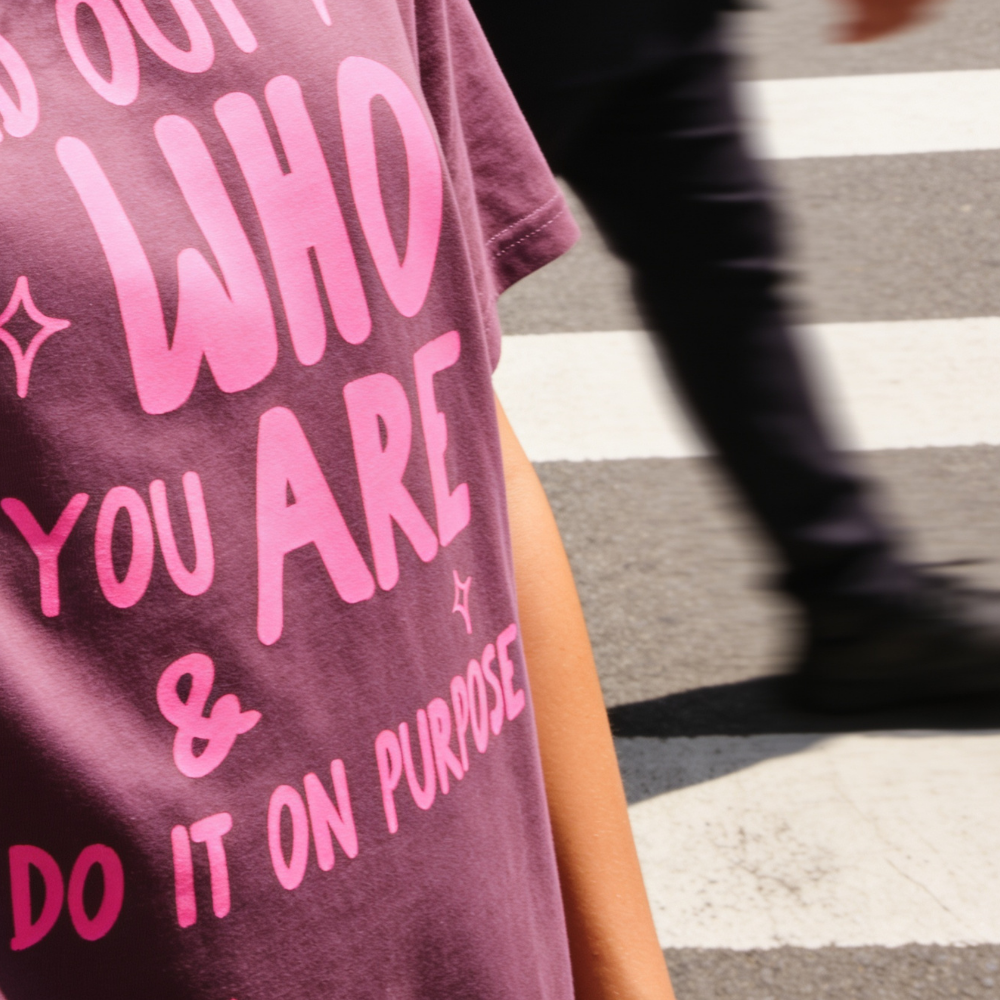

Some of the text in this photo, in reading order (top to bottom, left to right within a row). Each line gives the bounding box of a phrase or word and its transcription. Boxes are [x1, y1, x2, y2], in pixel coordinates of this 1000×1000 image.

[55, 56, 443, 415] WHO
[0, 330, 472, 646] YOU ARE
[8, 622, 526, 952] DO IT ON PURPOSE
[156, 652, 262, 779] &
